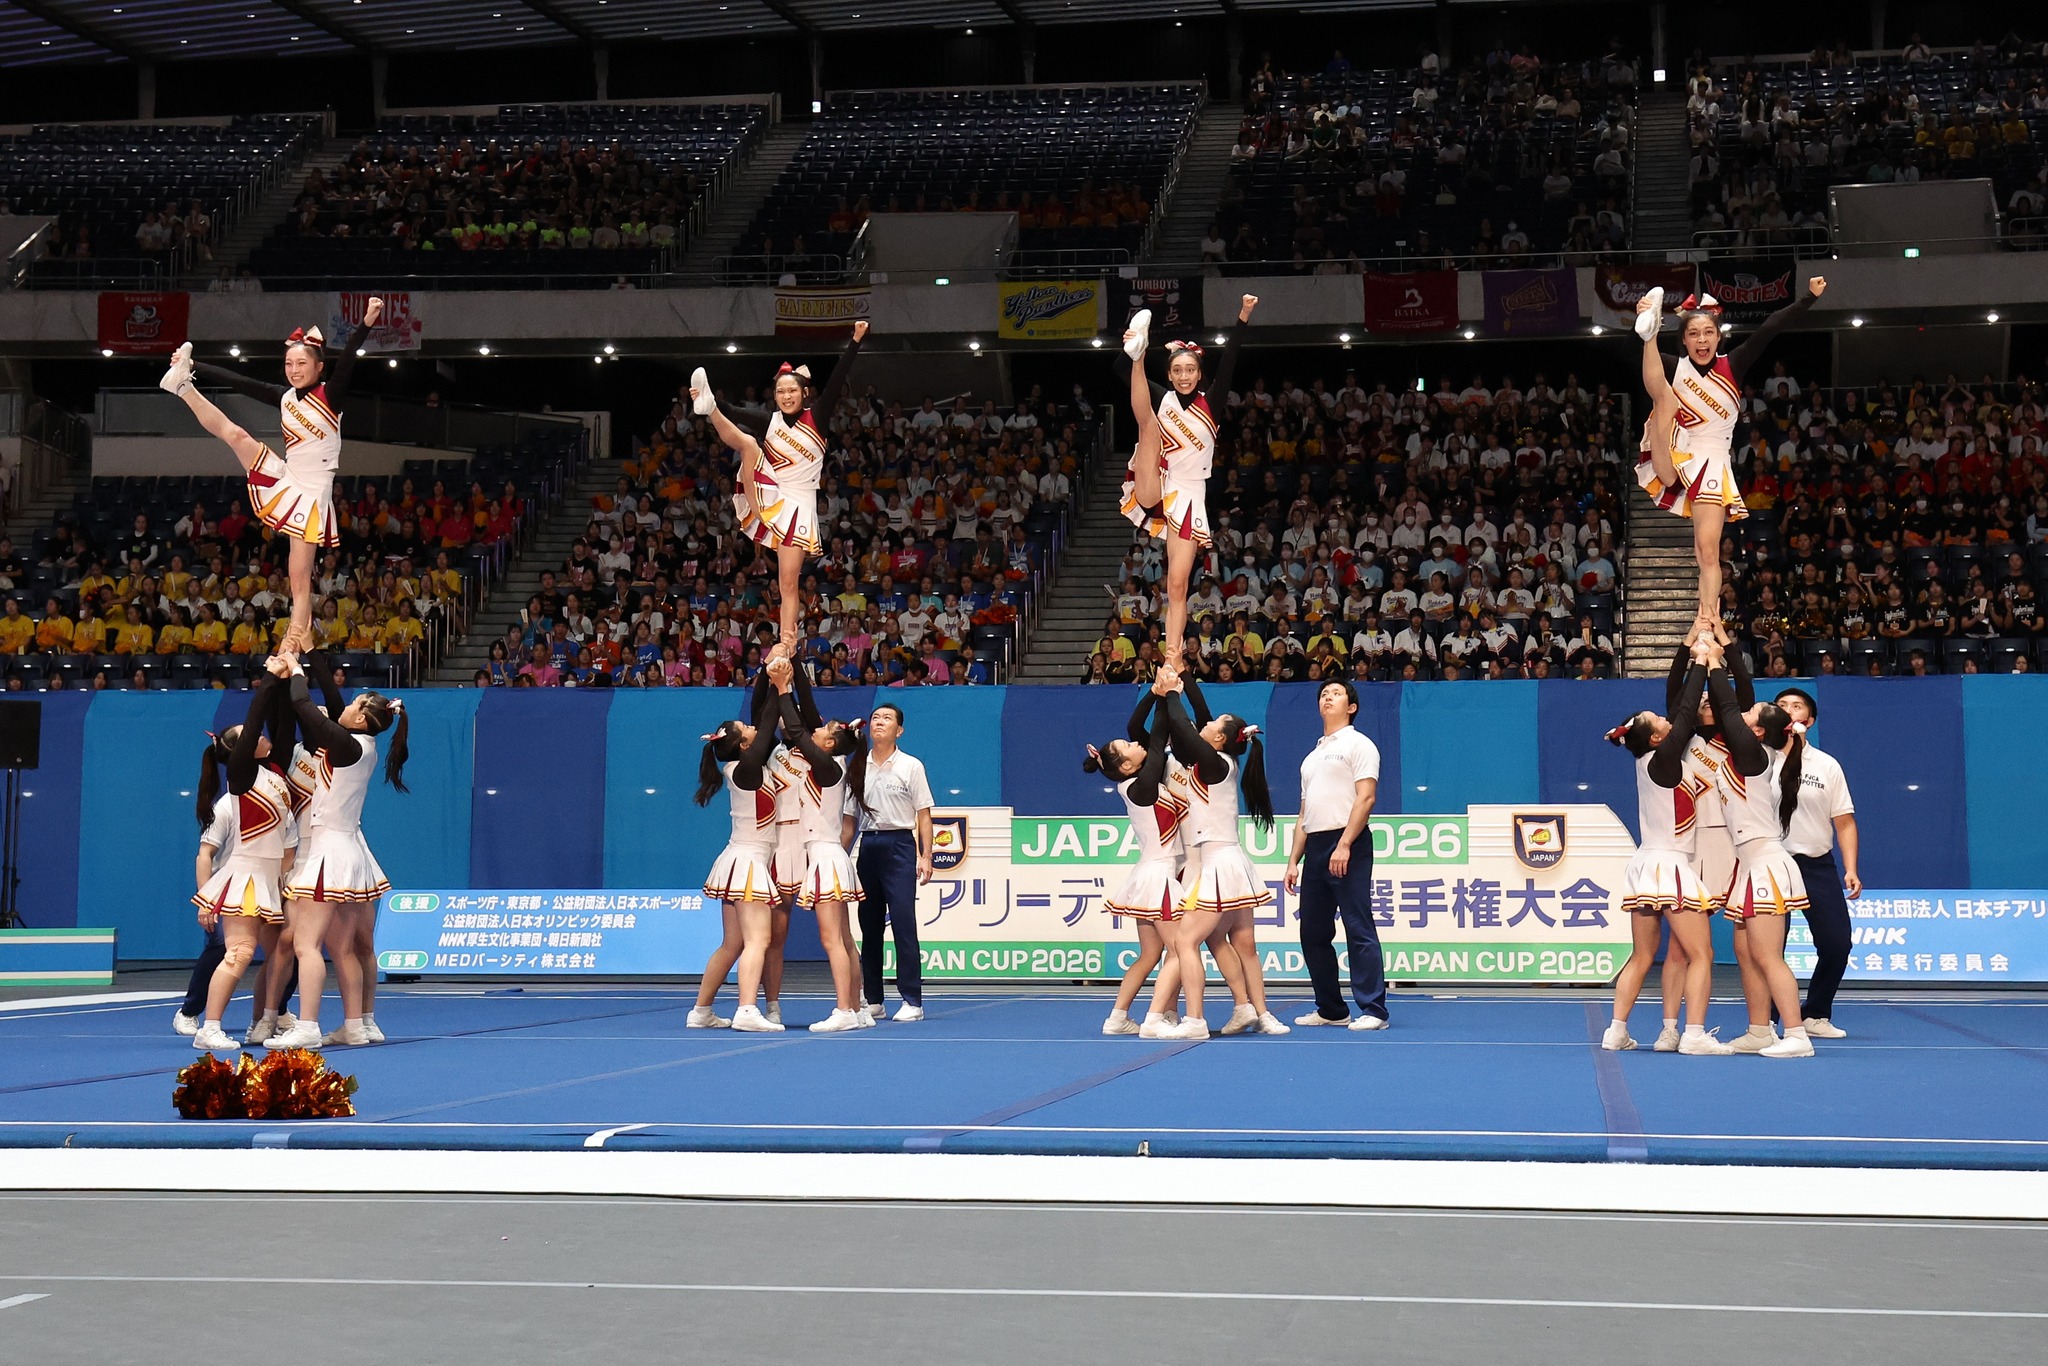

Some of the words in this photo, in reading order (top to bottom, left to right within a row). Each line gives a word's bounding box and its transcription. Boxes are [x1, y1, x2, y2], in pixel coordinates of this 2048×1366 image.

[1132, 280, 1180, 290] TOMBOYS
[1703, 270, 1791, 303] VORTEX
[775, 298, 855, 317] GARNETS
[1004, 286, 1059, 319] Yellow
[1014, 289, 1094, 330] Panthers
[1801, 779, 1825, 790] POTTER
[1021, 823, 1142, 858] JAPA
[1373, 823, 1461, 858] 026
[934, 855, 957, 863] JAPAN
[1531, 854, 1555, 862] JAPAN
[399, 897, 430, 910] 後援
[442, 914, 636, 929] 公益財団法人日本オリンピック委員会
[387, 954, 419, 967] 協賛
[972, 950, 1029, 971] CUP
[1031, 949, 1101, 973] 2026
[1475, 951, 1535, 973] CUP
[1540, 951, 1613, 975] 2026
